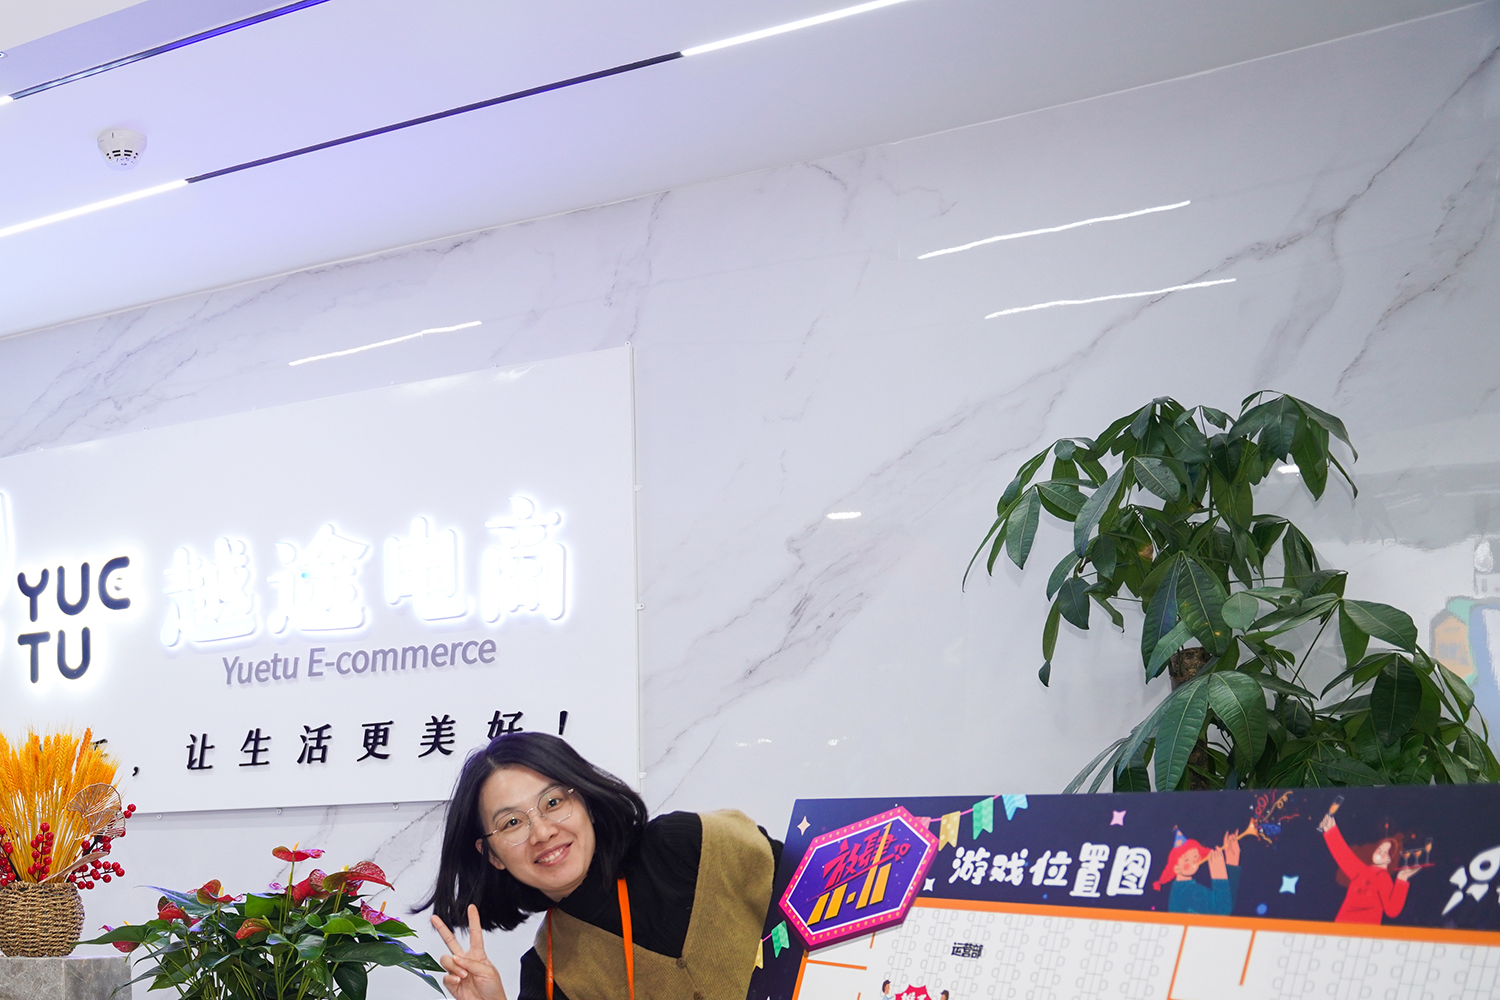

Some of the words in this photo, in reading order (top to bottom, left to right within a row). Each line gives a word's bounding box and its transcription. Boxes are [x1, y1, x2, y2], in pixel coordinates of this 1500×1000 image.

[159, 495, 568, 647] 越途电商
[17, 630, 90, 683] TU
[221, 650, 299, 685] Yuetu
[308, 639, 497, 677] E-commerce
[948, 842, 1152, 898] 游戏位置图
[951, 941, 984, 959] 运营部
